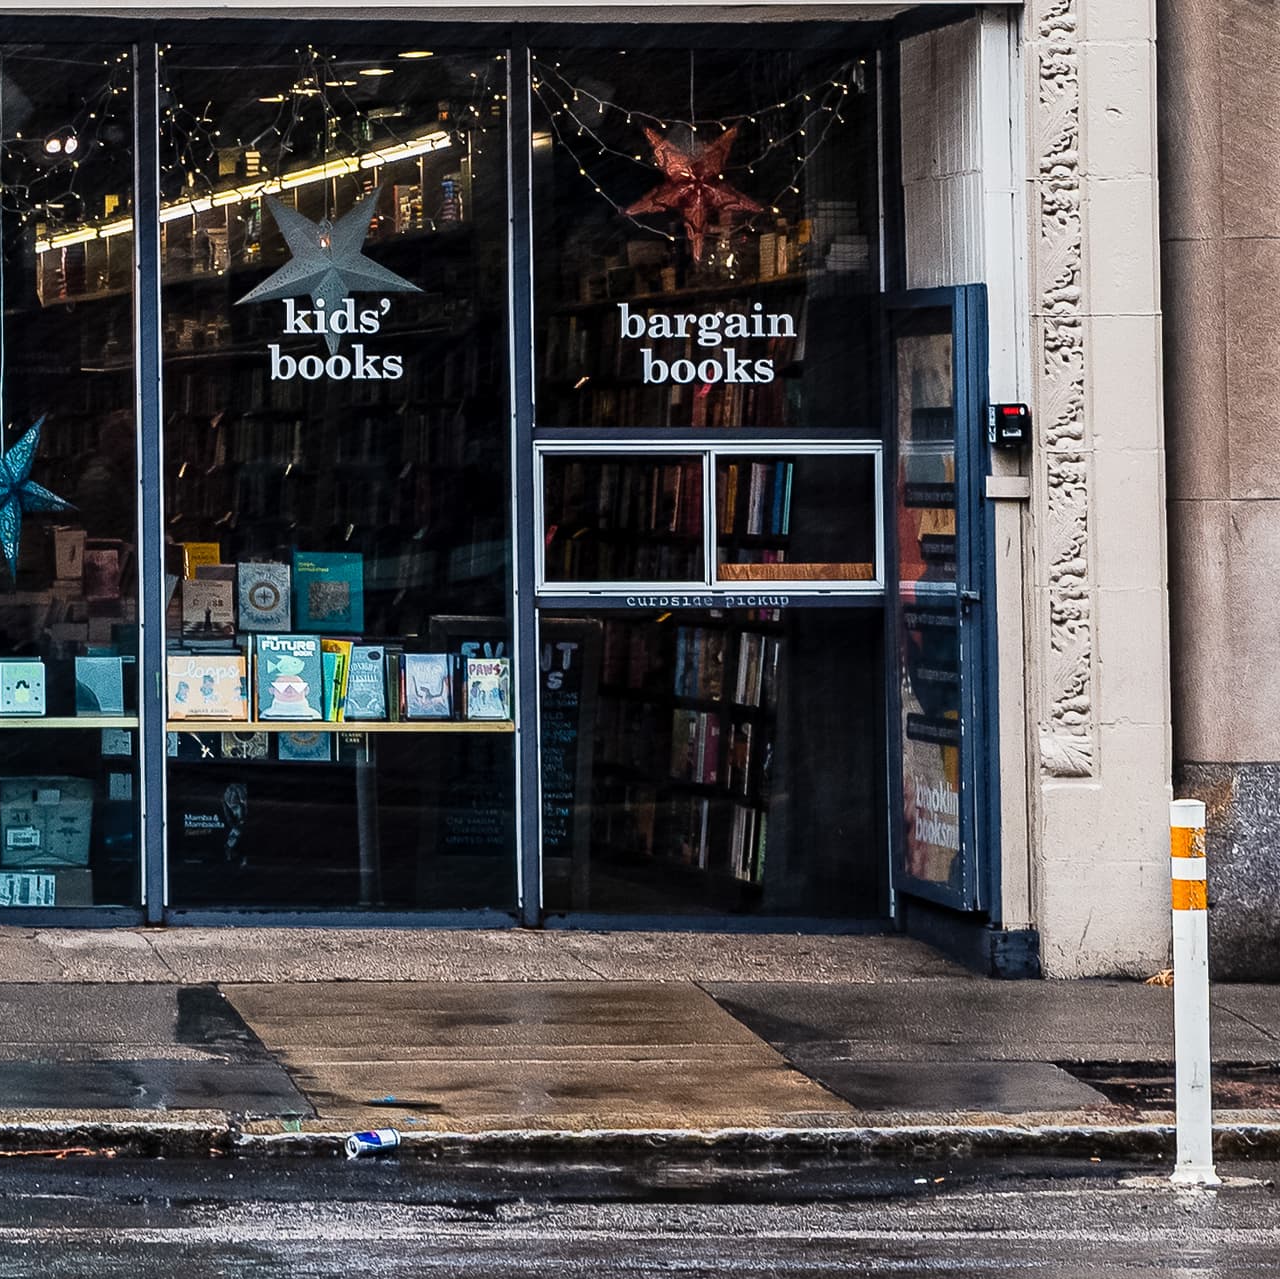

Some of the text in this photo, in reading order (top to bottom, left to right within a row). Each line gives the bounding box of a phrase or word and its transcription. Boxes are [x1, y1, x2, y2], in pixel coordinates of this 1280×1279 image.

[282, 298, 392, 334] kids’
[616, 303, 797, 347] bargain
[267, 344, 404, 381] books
[640, 348, 776, 384] books
[626, 594, 790, 609] curbside pickup
[261, 640, 316, 652] FUTURE
[468, 663, 501, 676] PAWS
[915, 776, 959, 816] brooklin
[184, 813, 213, 822] Mamba
